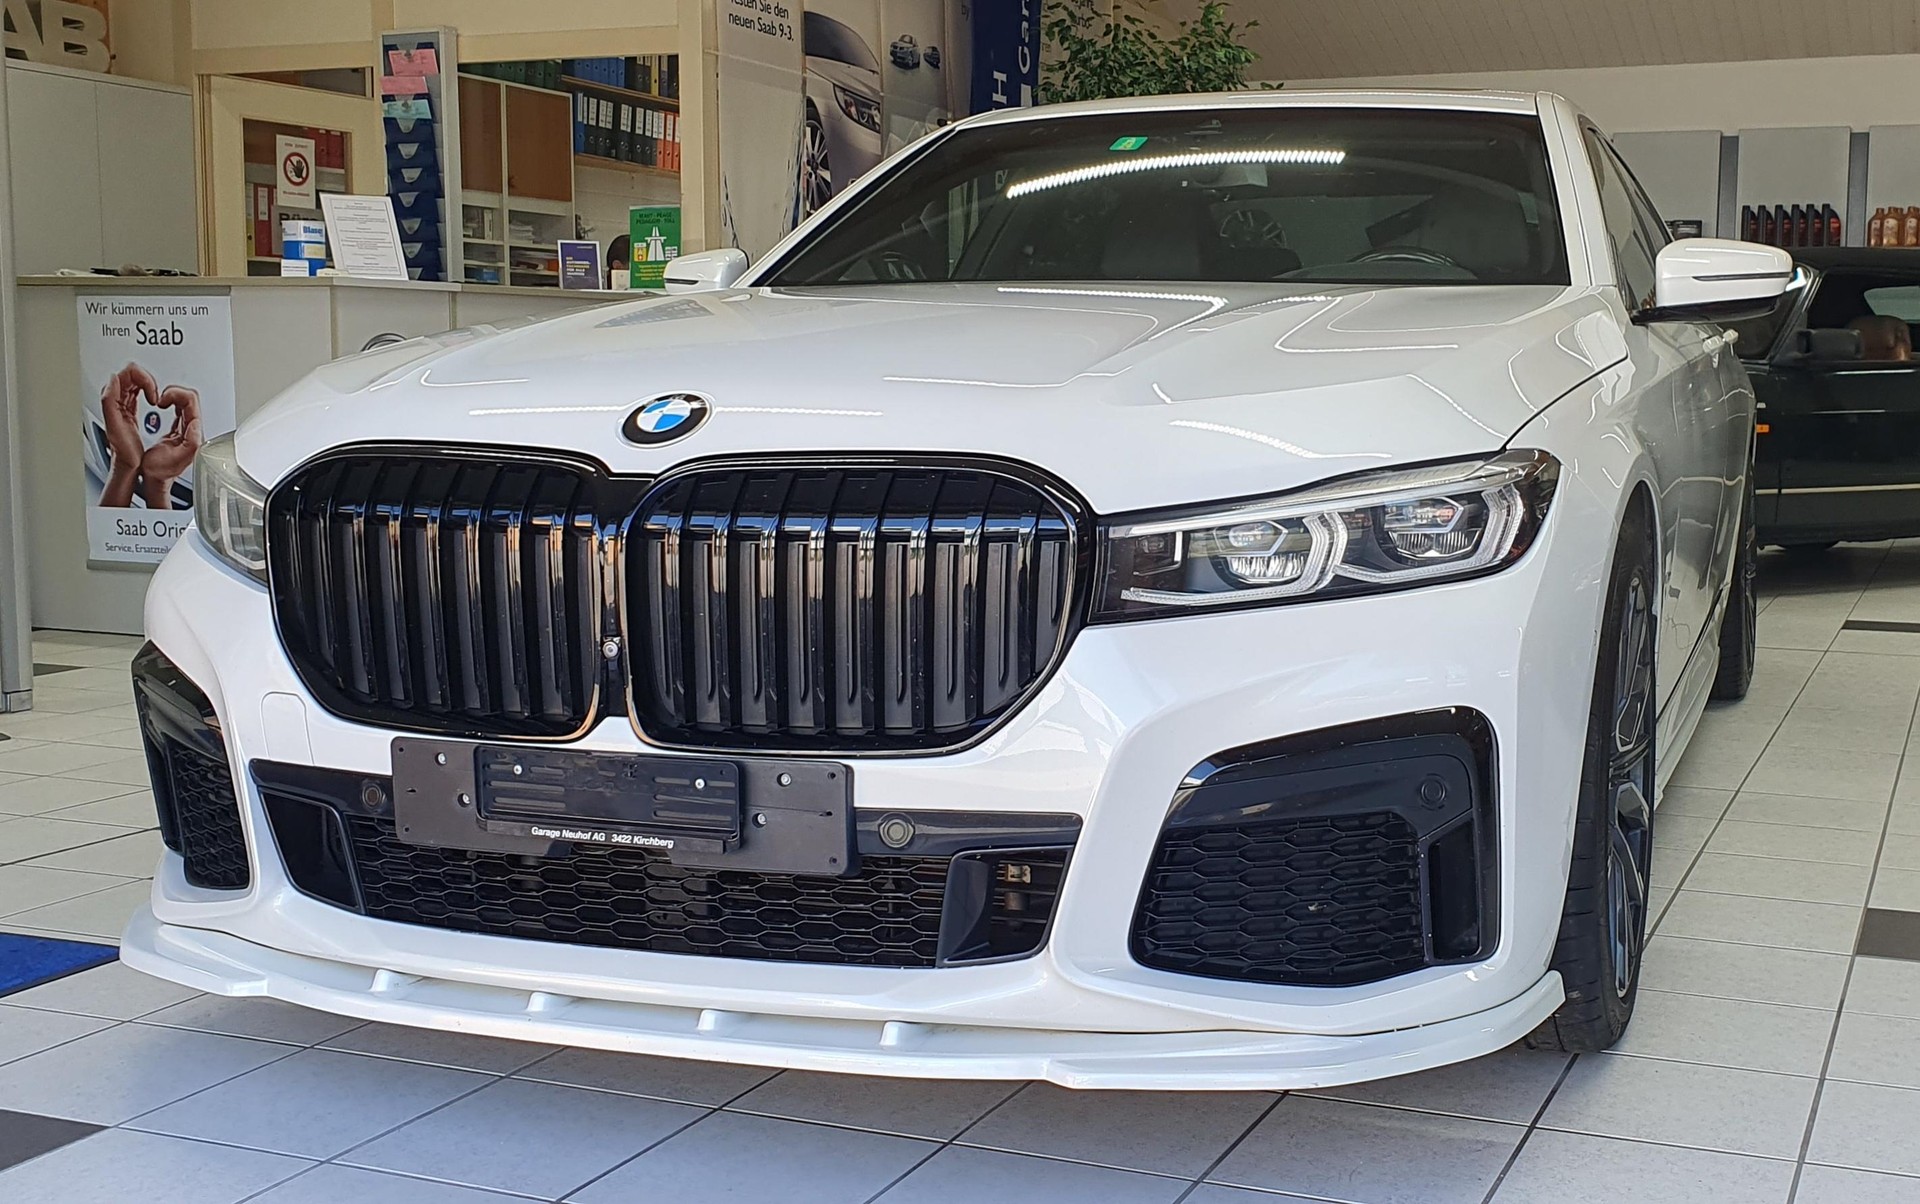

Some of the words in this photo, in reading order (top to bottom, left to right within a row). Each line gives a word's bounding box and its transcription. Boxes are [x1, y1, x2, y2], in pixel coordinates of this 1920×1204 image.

[759, 0, 772, 14] Sie
[774, 2, 789, 19] den
[729, 13, 755, 30] neuen
[757, 17, 777, 36] Saab
[779, 23, 794, 41] 9-3.
[85, 301, 108, 315] Wir
[111, 301, 165, 316] kümmern
[168, 306, 187, 316] uns
[191, 306, 209, 316] um
[102, 323, 130, 337] Ihren
[135, 320, 184, 346] Saab
[116, 518, 148, 537] Saab
[104, 542, 134, 554] Service,
[531, 826, 561, 839] Garage
[562, 829, 591, 841] Neuhof
[592, 832, 605, 841] AG
[611, 833, 632, 843] 3422
[632, 835, 675, 849] Kirchberg
